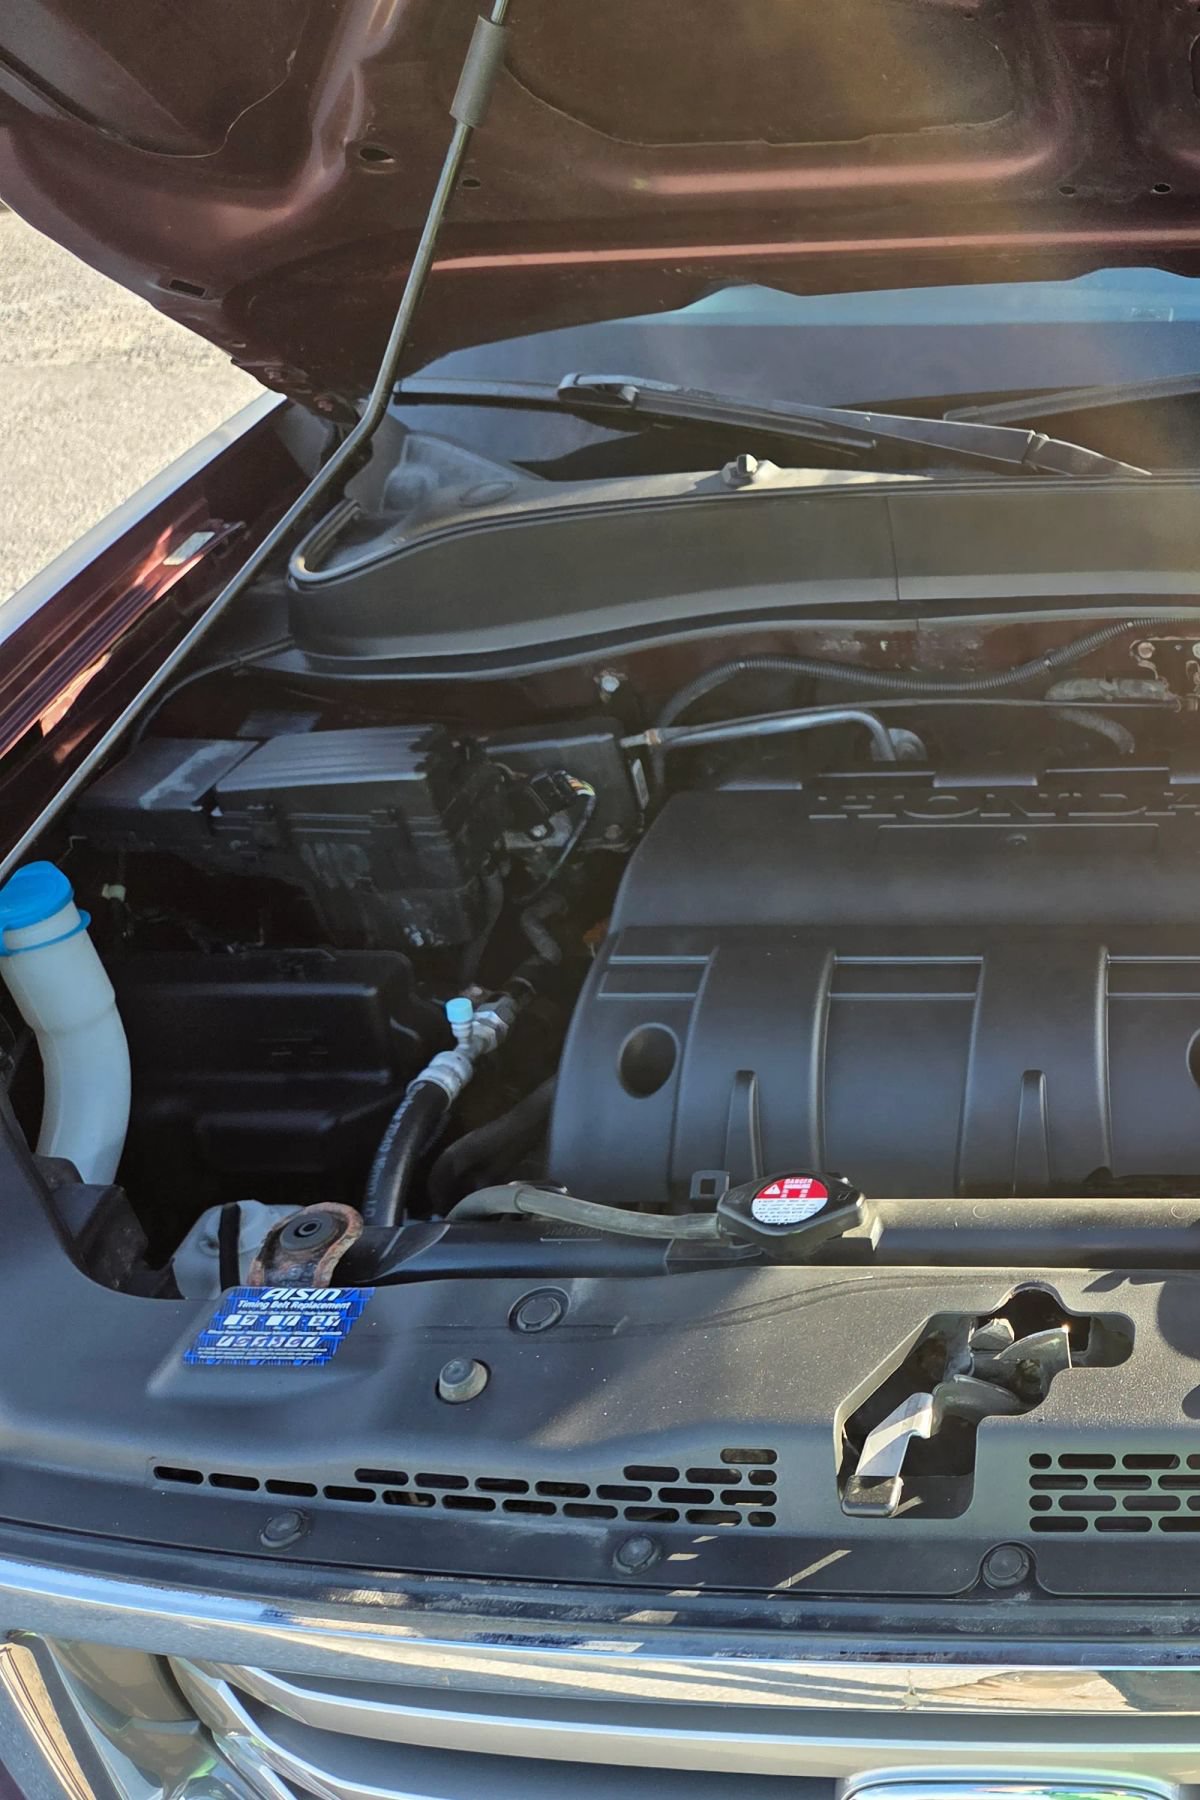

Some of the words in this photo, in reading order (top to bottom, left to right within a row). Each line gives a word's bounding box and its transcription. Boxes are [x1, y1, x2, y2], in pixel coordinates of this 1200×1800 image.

[261, 1288, 342, 1300] AISIN
[237, 1300, 269, 1310] Timing
[270, 1300, 290, 1309] Belt
[290, 1301, 352, 1311] Replacement
